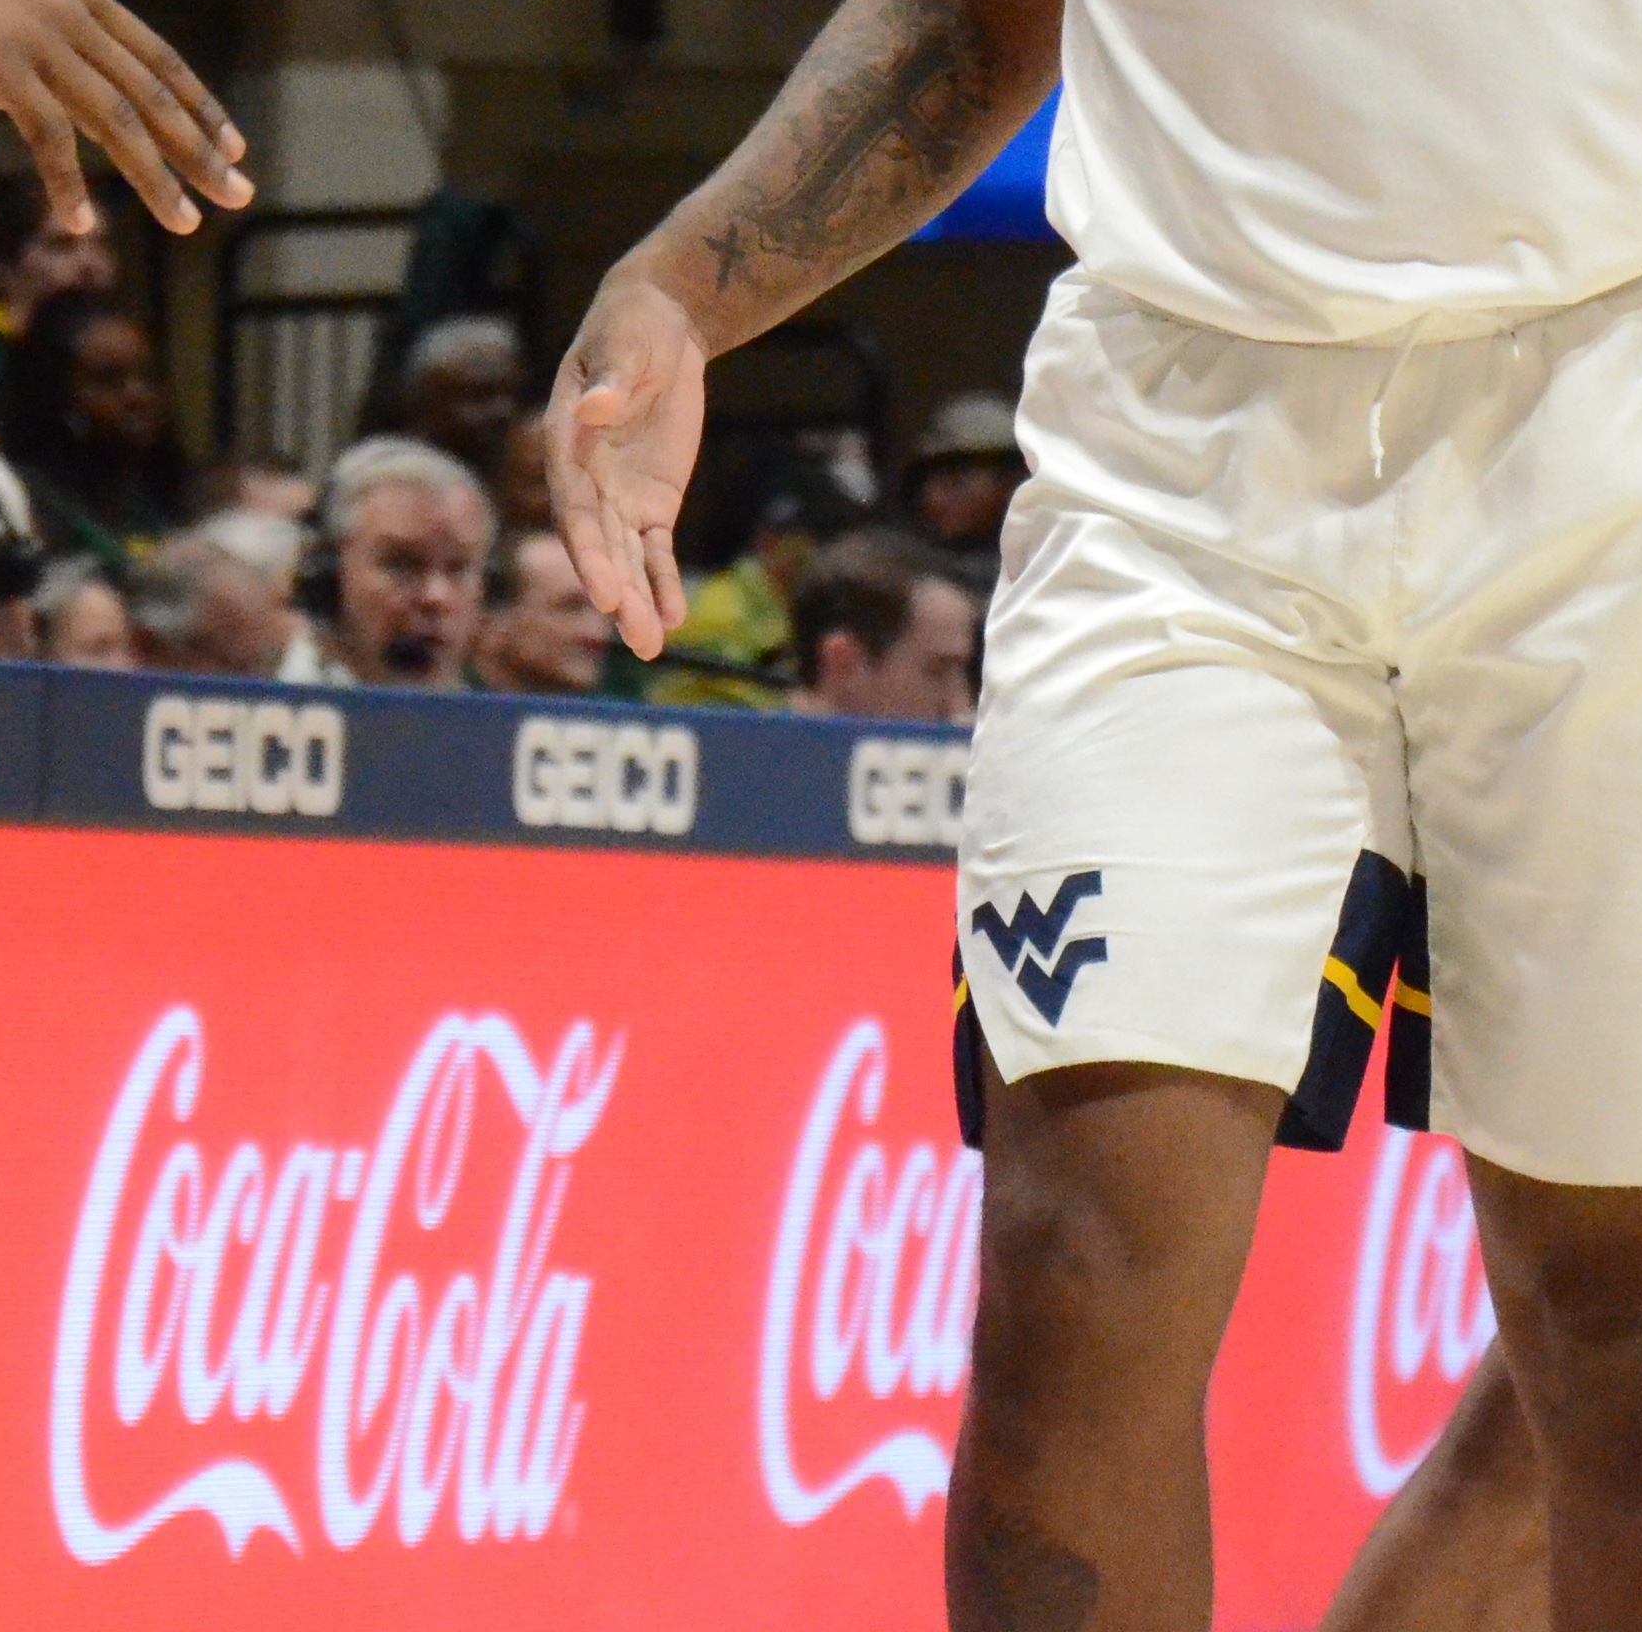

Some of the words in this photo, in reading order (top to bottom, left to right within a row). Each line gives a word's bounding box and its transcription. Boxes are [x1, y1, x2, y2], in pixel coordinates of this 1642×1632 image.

[144, 695, 345, 818] GEICO
[512, 715, 698, 836] GEICO
[49, 1003, 627, 1567] Coca-Cola
